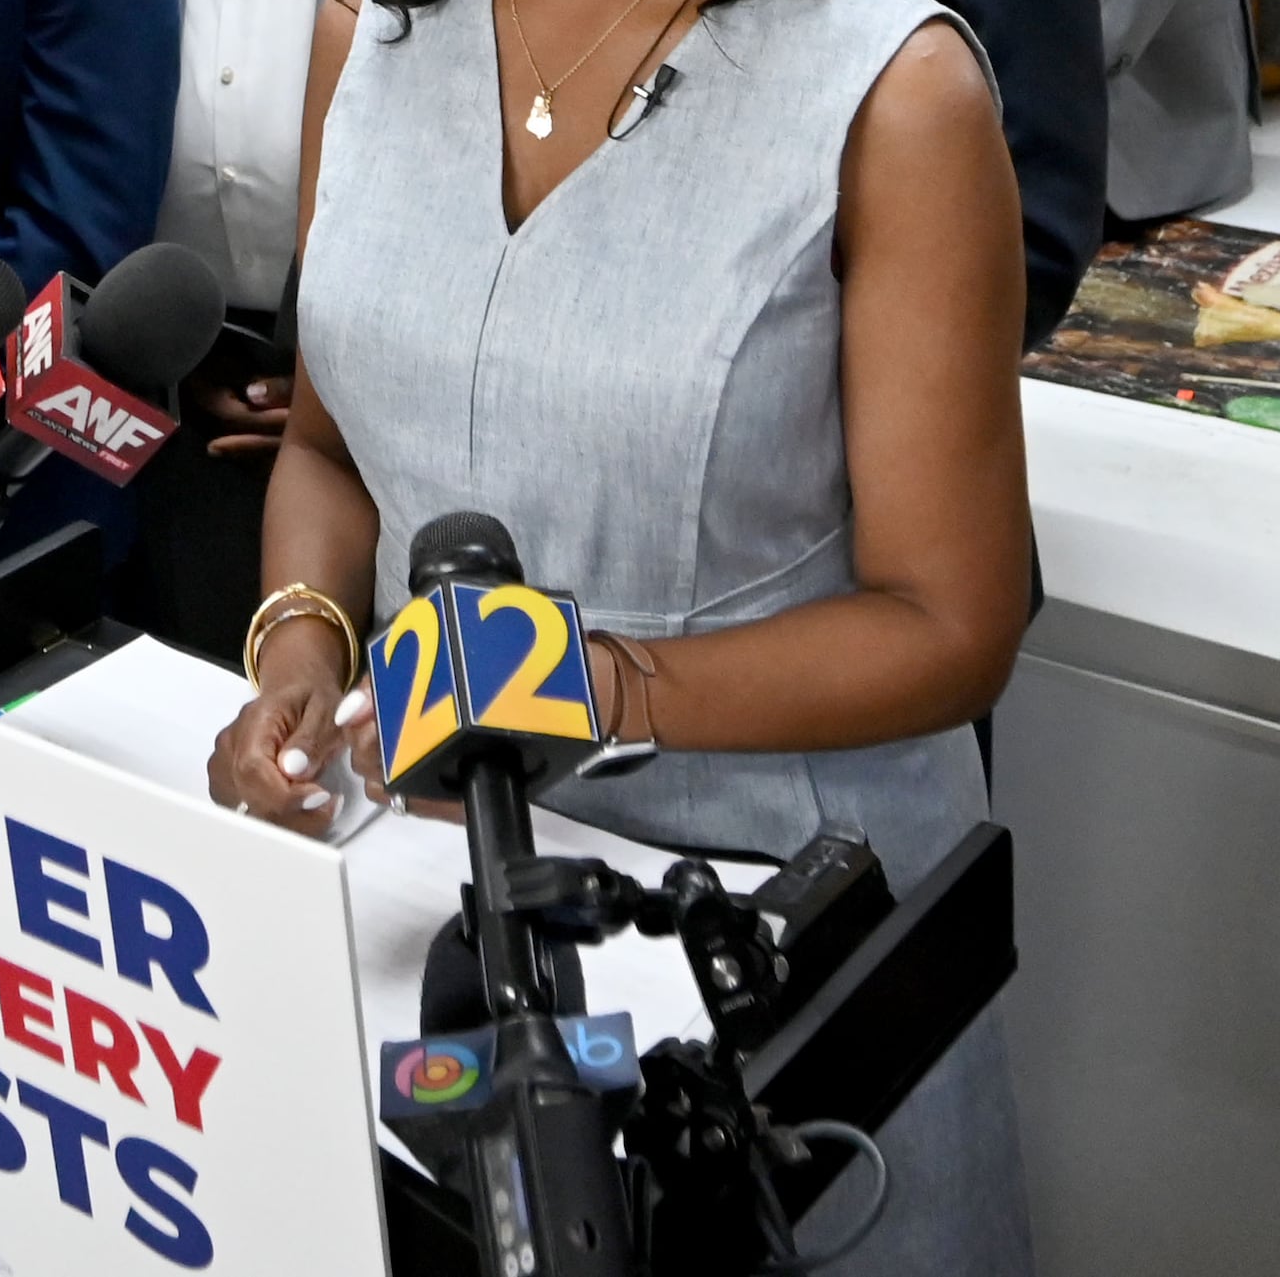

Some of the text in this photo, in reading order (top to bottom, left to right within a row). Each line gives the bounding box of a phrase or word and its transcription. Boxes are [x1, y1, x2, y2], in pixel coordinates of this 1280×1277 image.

[23, 301, 53, 378] ANF
[26, 410, 68, 437] ATLANTA
[69, 432, 99, 453] NEWS
[35, 385, 164, 452] ANF
[383, 596, 459, 783] 2
[475, 584, 597, 741] 2
